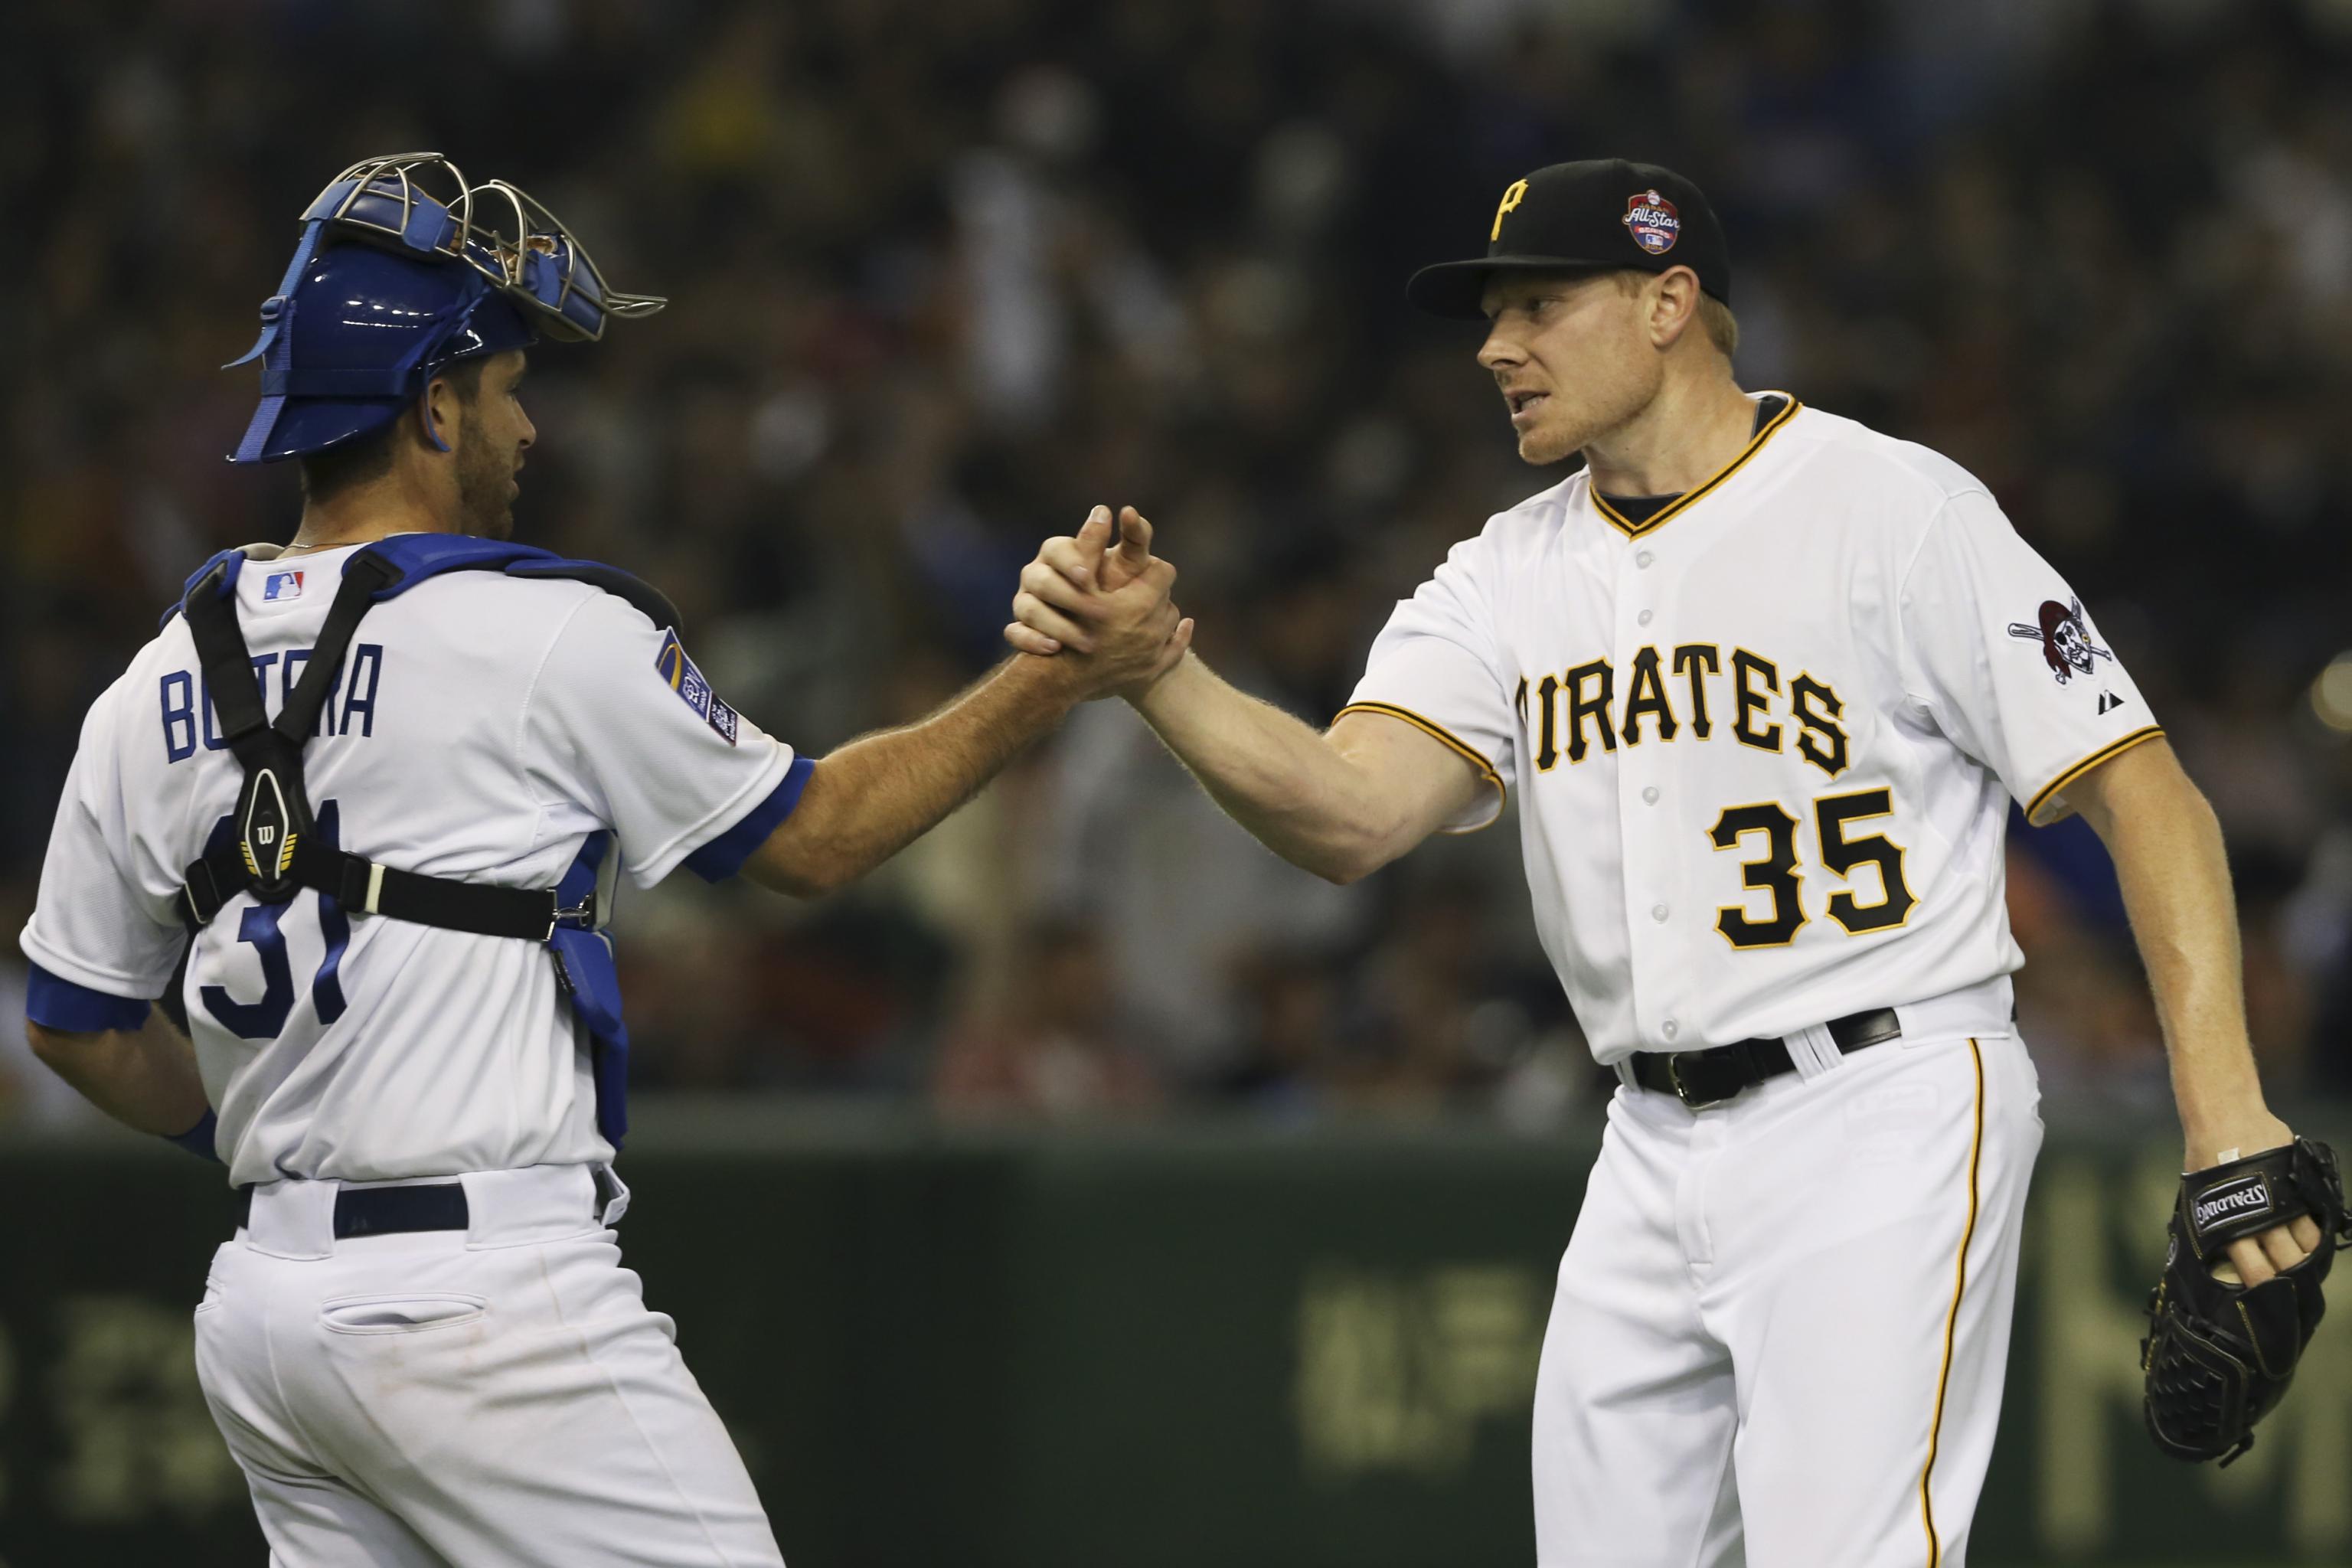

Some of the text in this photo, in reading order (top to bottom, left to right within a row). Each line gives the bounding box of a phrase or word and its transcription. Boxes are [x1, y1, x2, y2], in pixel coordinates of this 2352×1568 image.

[1491, 178, 1529, 242] P
[1625, 207, 1680, 228] All-Star
[1705, 786, 1921, 950] 35
[200, 799, 351, 1040] 31
[2196, 1184, 2265, 1225] SPALDING
